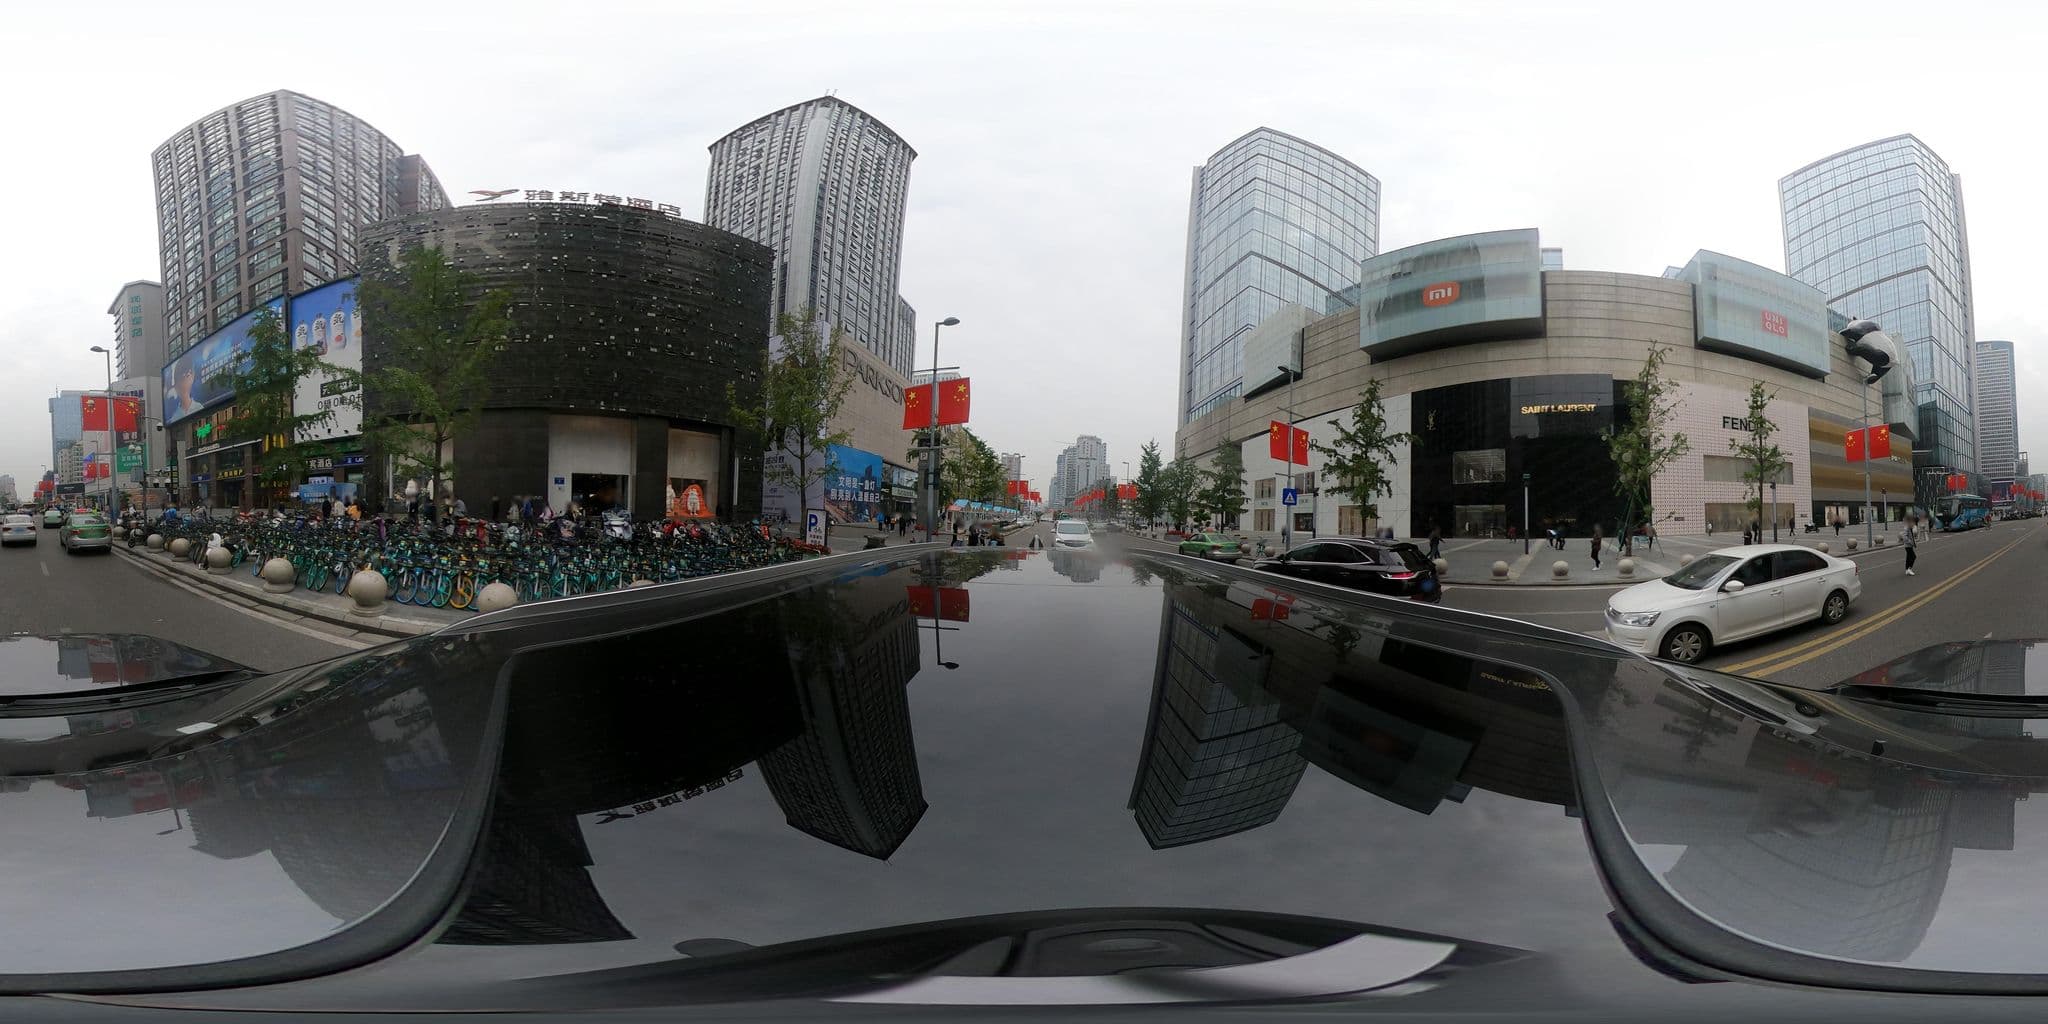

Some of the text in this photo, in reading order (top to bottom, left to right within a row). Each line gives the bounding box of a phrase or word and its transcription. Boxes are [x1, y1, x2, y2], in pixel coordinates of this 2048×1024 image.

[1521, 404, 1597, 414] SAINT LAURENT
[1722, 416, 1760, 432] FEND
[808, 513, 818, 532] P
